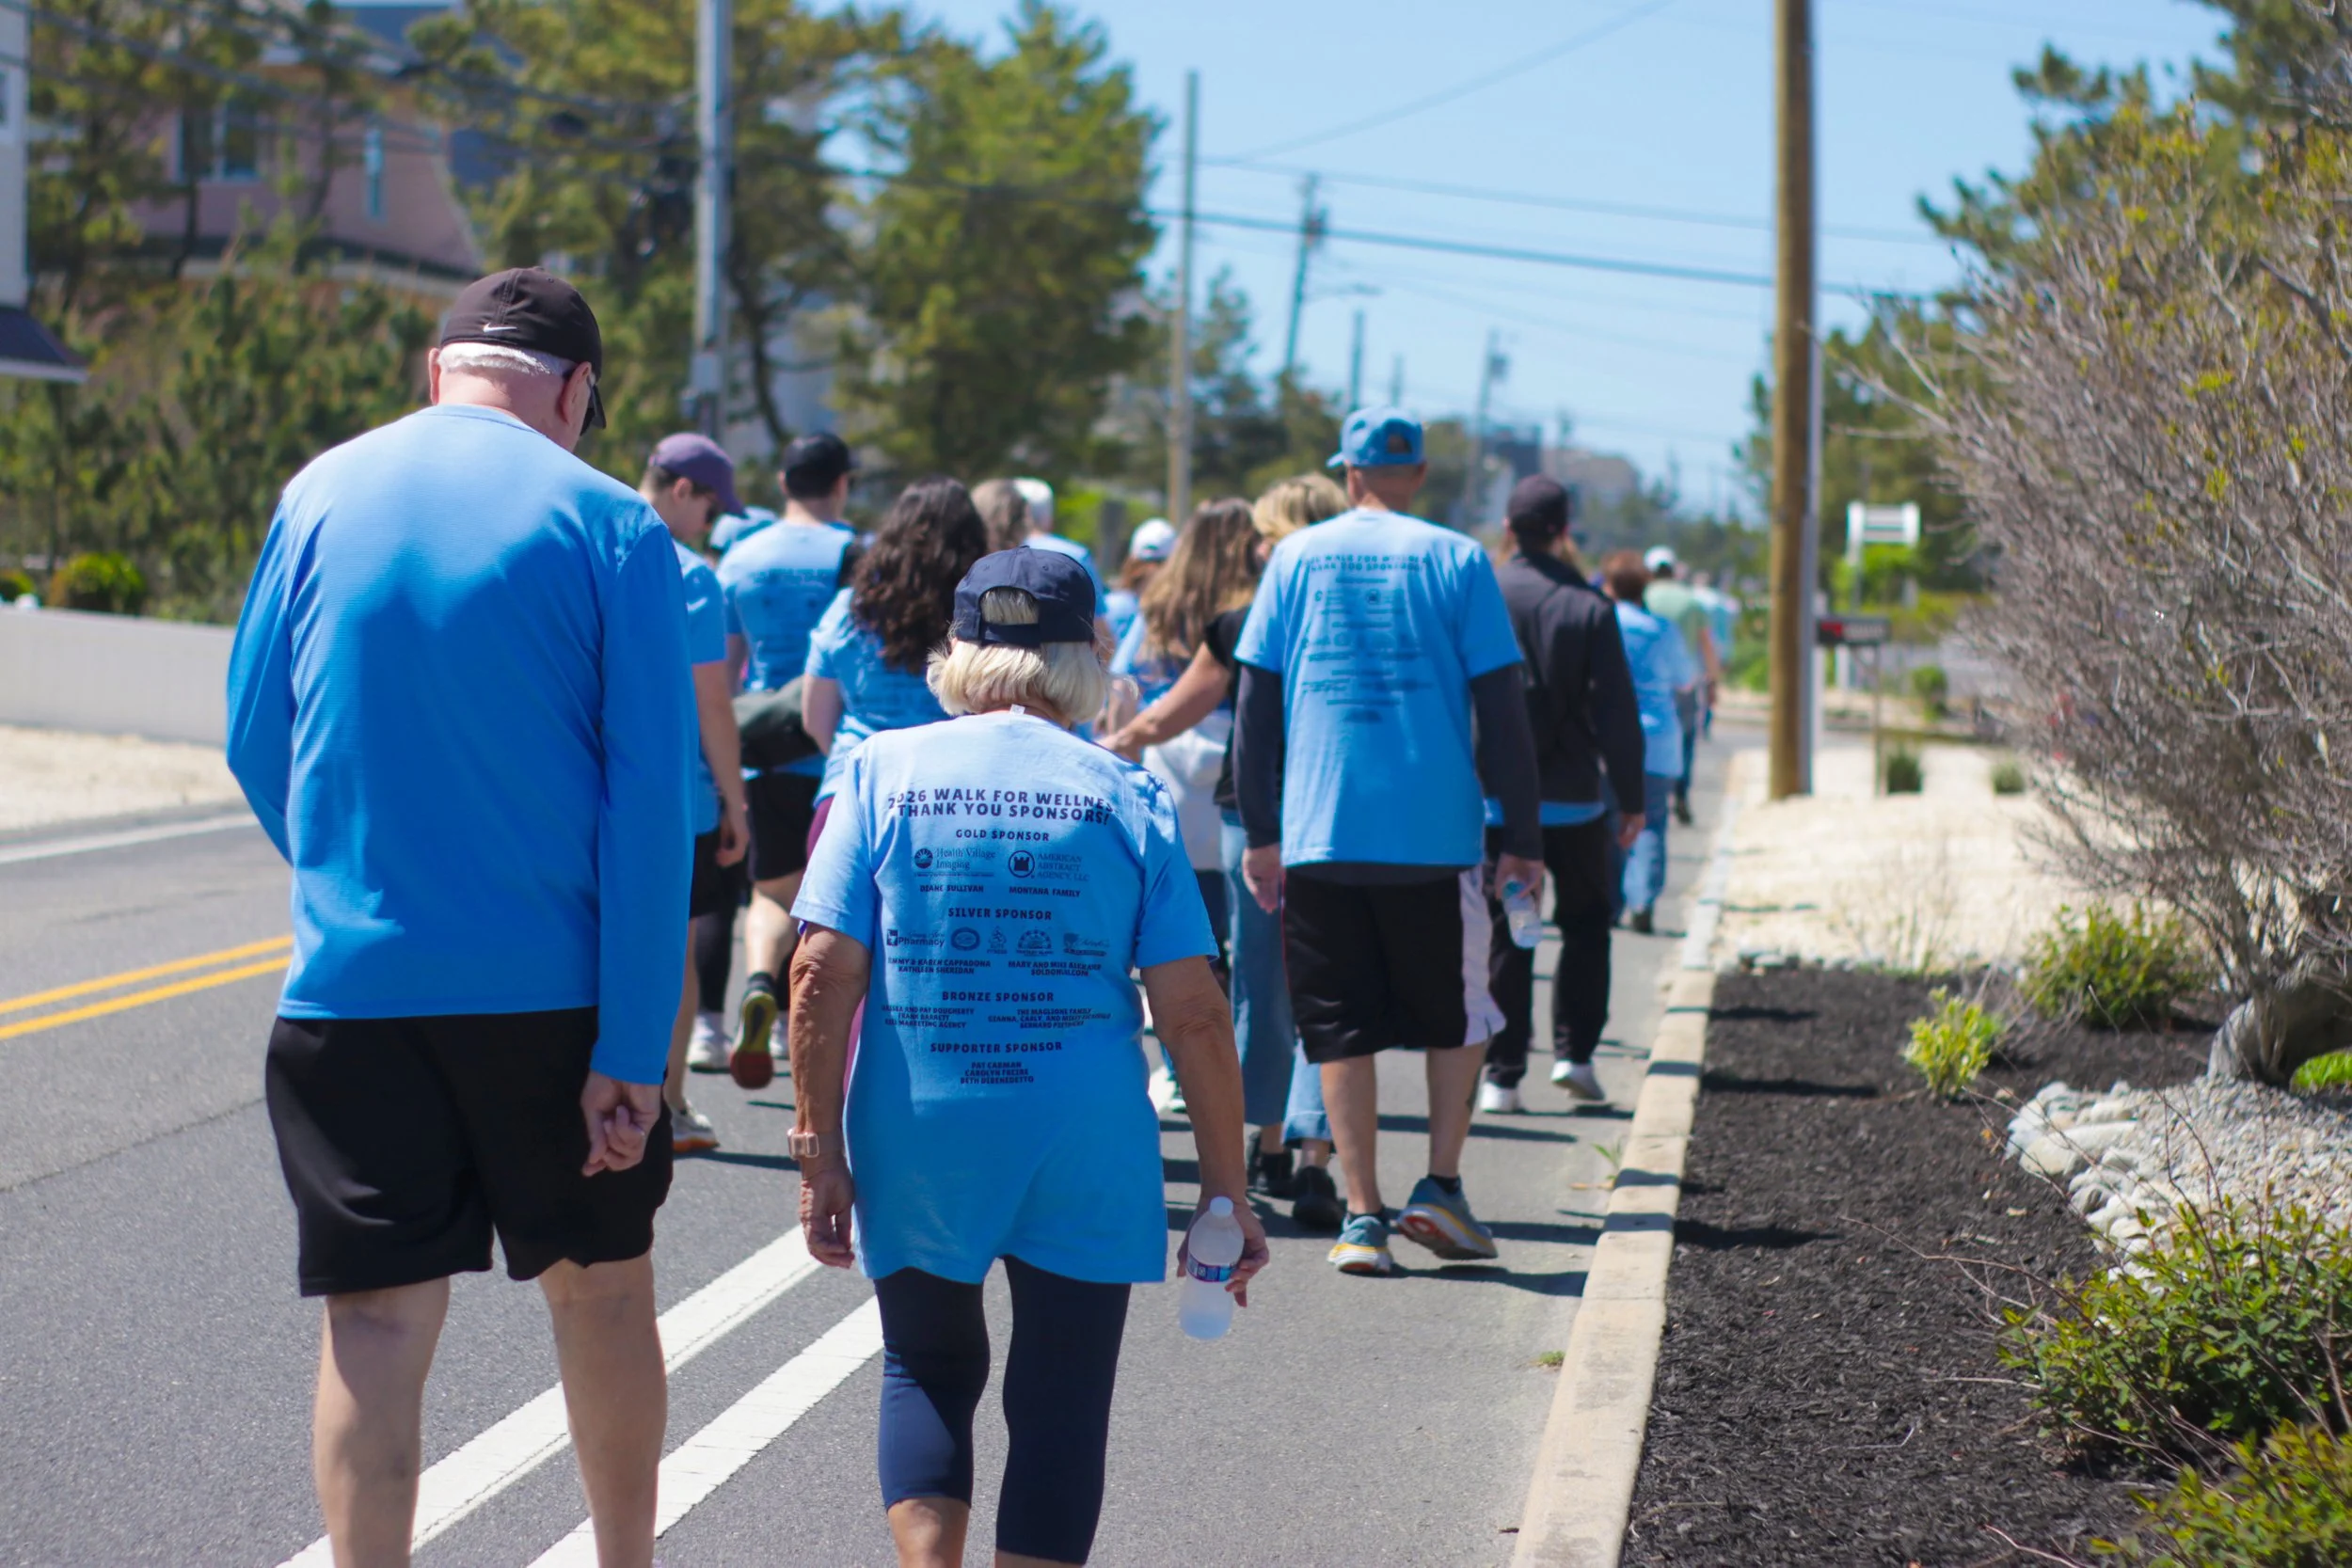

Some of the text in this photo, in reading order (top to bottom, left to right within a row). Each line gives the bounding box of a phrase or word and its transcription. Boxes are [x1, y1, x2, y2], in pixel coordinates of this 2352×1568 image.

[888, 790, 927, 809] 2026
[934, 788, 986, 801] WALK
[993, 790, 1027, 802] FOR
[898, 802, 1110, 825] THANK YOU SPONSORS!
[956, 829, 1049, 841] GOLD SPONSOR
[965, 847, 995, 860] Village
[1038, 852, 1083, 863] AMERICAN
[936, 861, 970, 870] Imaging
[1038, 862, 1081, 871] ABSTRACT
[920, 884, 984, 893] DIANE SULLIVAN
[1009, 886, 1081, 897] MONTANA FAMILY
[948, 908, 1052, 920] SILVER SPONSOR
[898, 937, 946, 947] Pharmacy
[942, 991, 1055, 1002] BRONZE SPONSOR
[930, 1041, 1062, 1053] SUPPORTER SPONSOR
